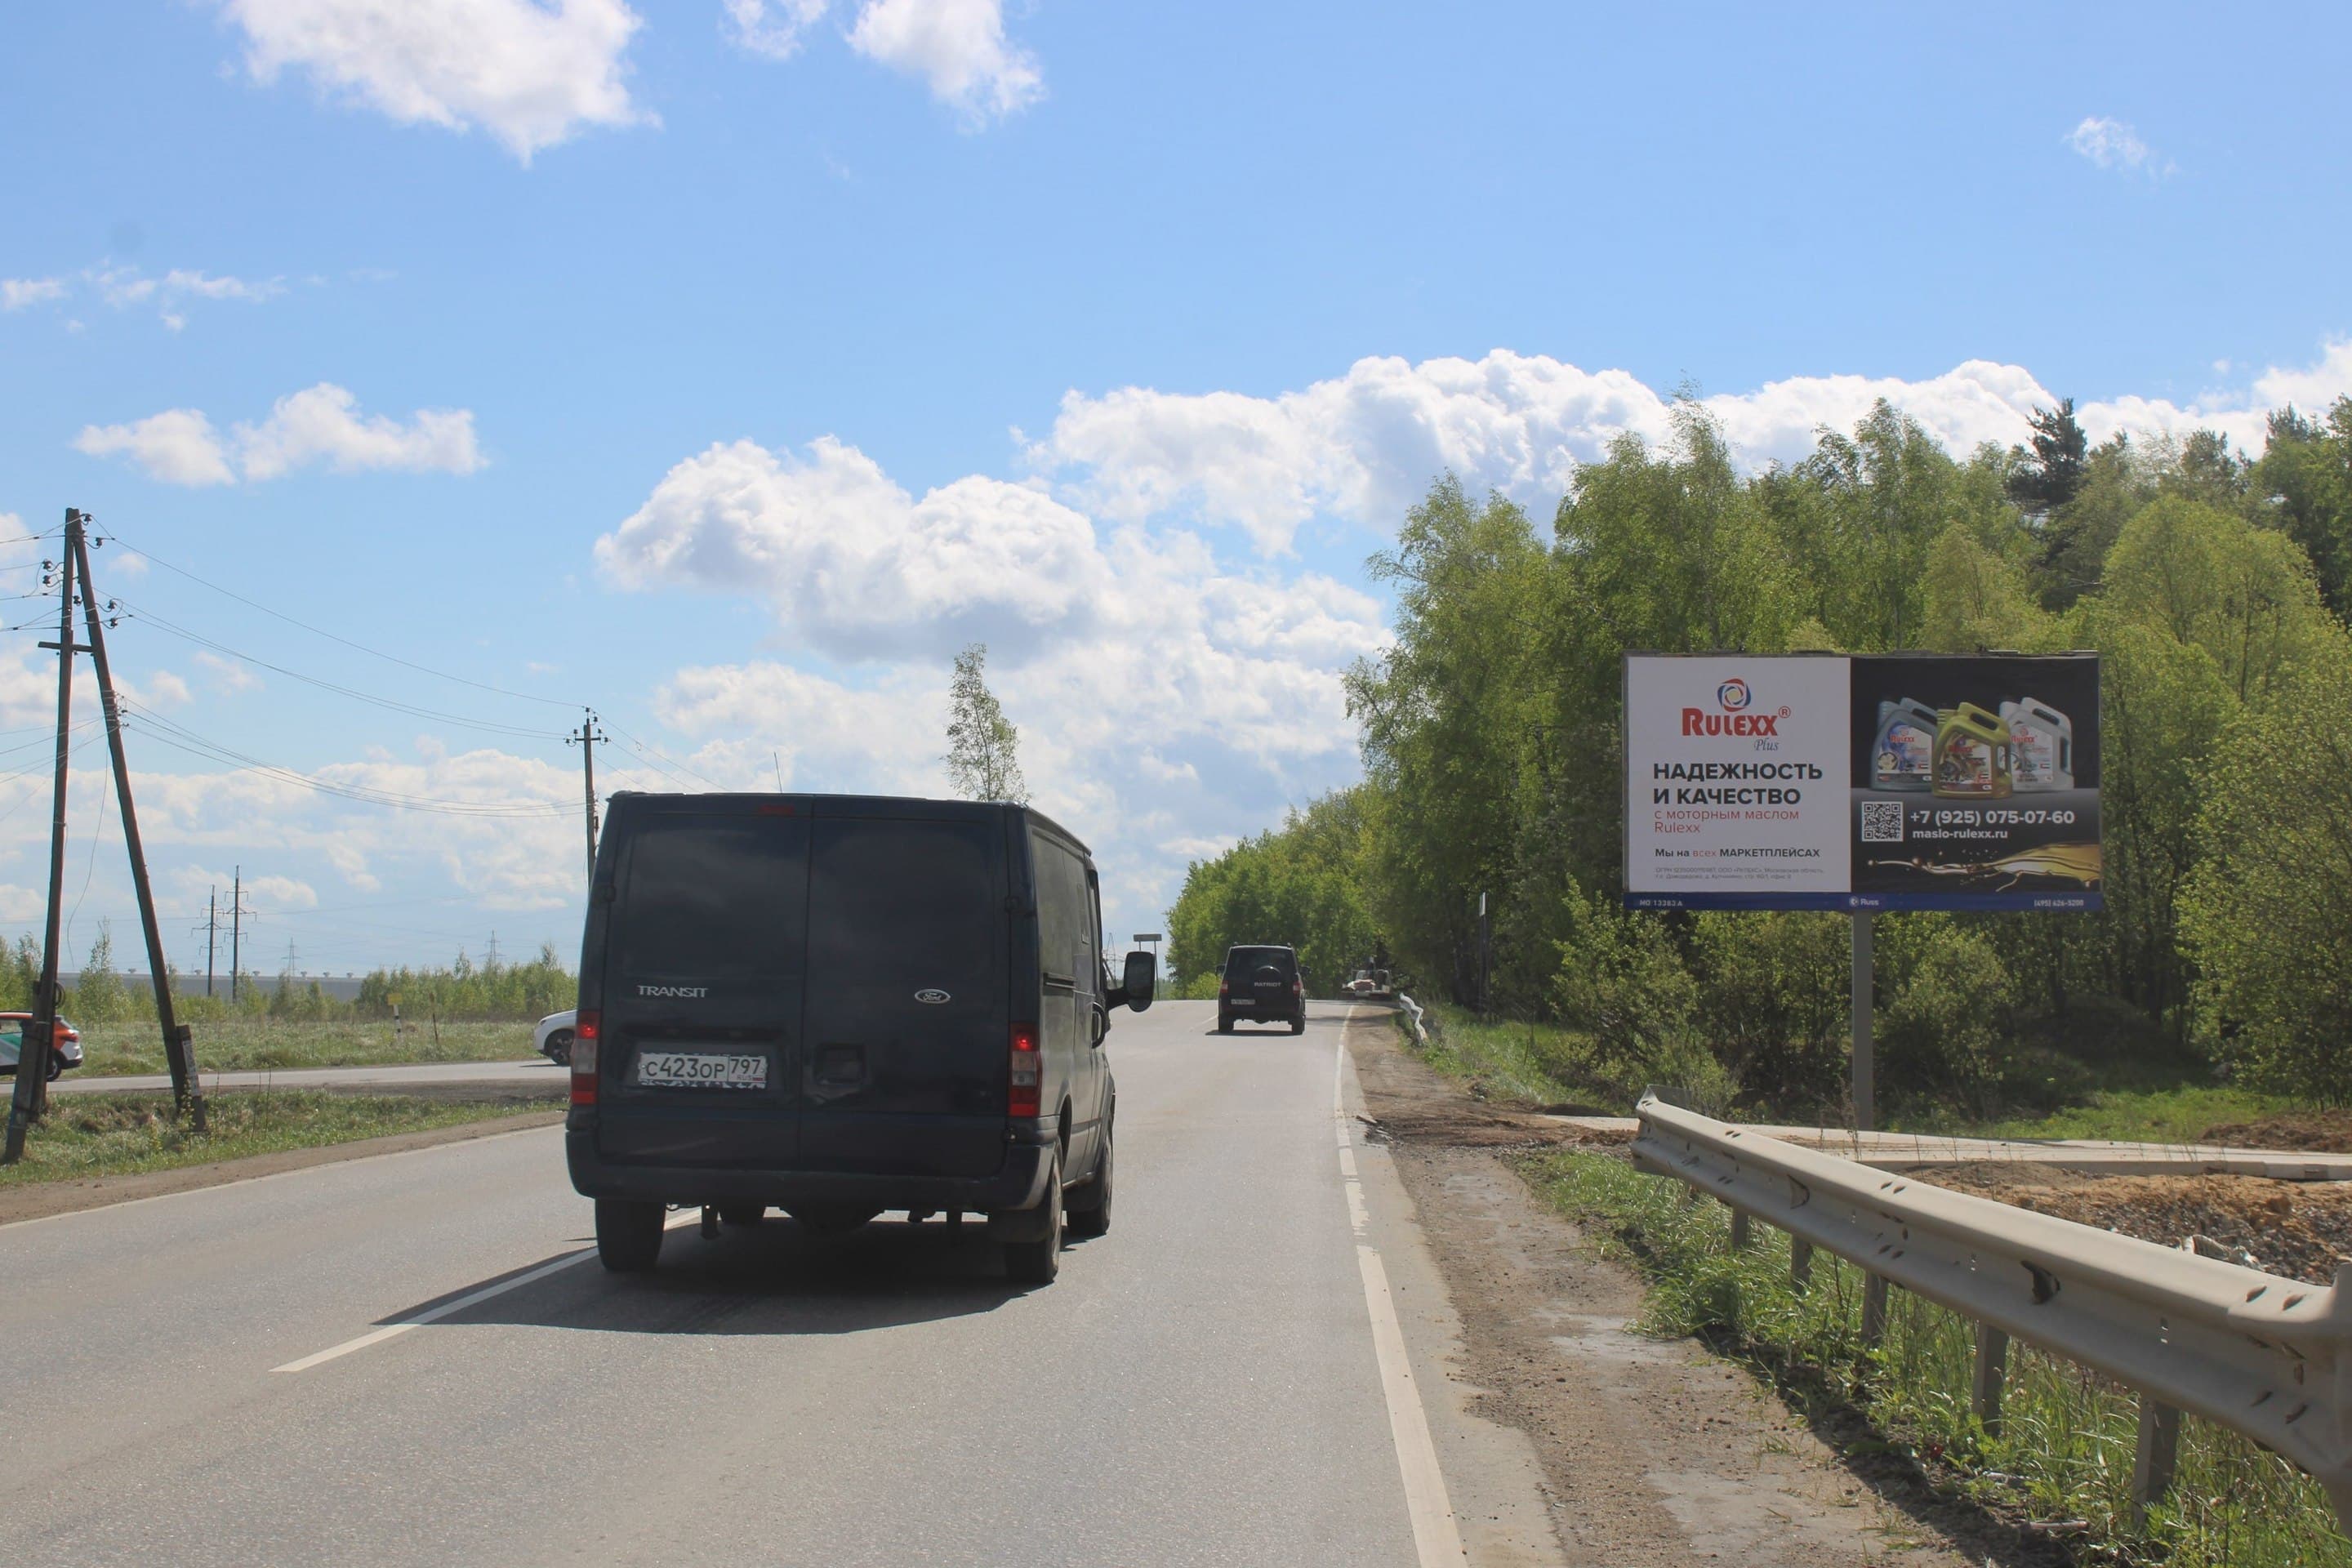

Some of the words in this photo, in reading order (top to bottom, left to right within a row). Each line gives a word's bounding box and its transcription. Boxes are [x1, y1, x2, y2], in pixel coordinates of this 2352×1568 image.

[1755, 738, 1779, 751] Plus
[1653, 763, 1823, 782] НАДЕЖНОСТЬ
[1653, 788, 1669, 804] И
[1677, 787, 1801, 804] КАЧЕСТВО
[1654, 810, 1662, 820] с
[1666, 810, 1740, 822] моторным
[1744, 810, 1799, 820] маслом
[1910, 811, 1931, 824] +7
[1935, 810, 1981, 826] (925)
[1985, 811, 2075, 824] 075-07-60
[1655, 822, 1700, 833] Rulexx
[1913, 829, 2008, 839] maslo-rulexx.ru
[1655, 849, 1674, 857] Мы
[1720, 847, 1820, 857] МАРКЕТПЛЕЙСАХ
[637, 985, 709, 997] TRANSIT
